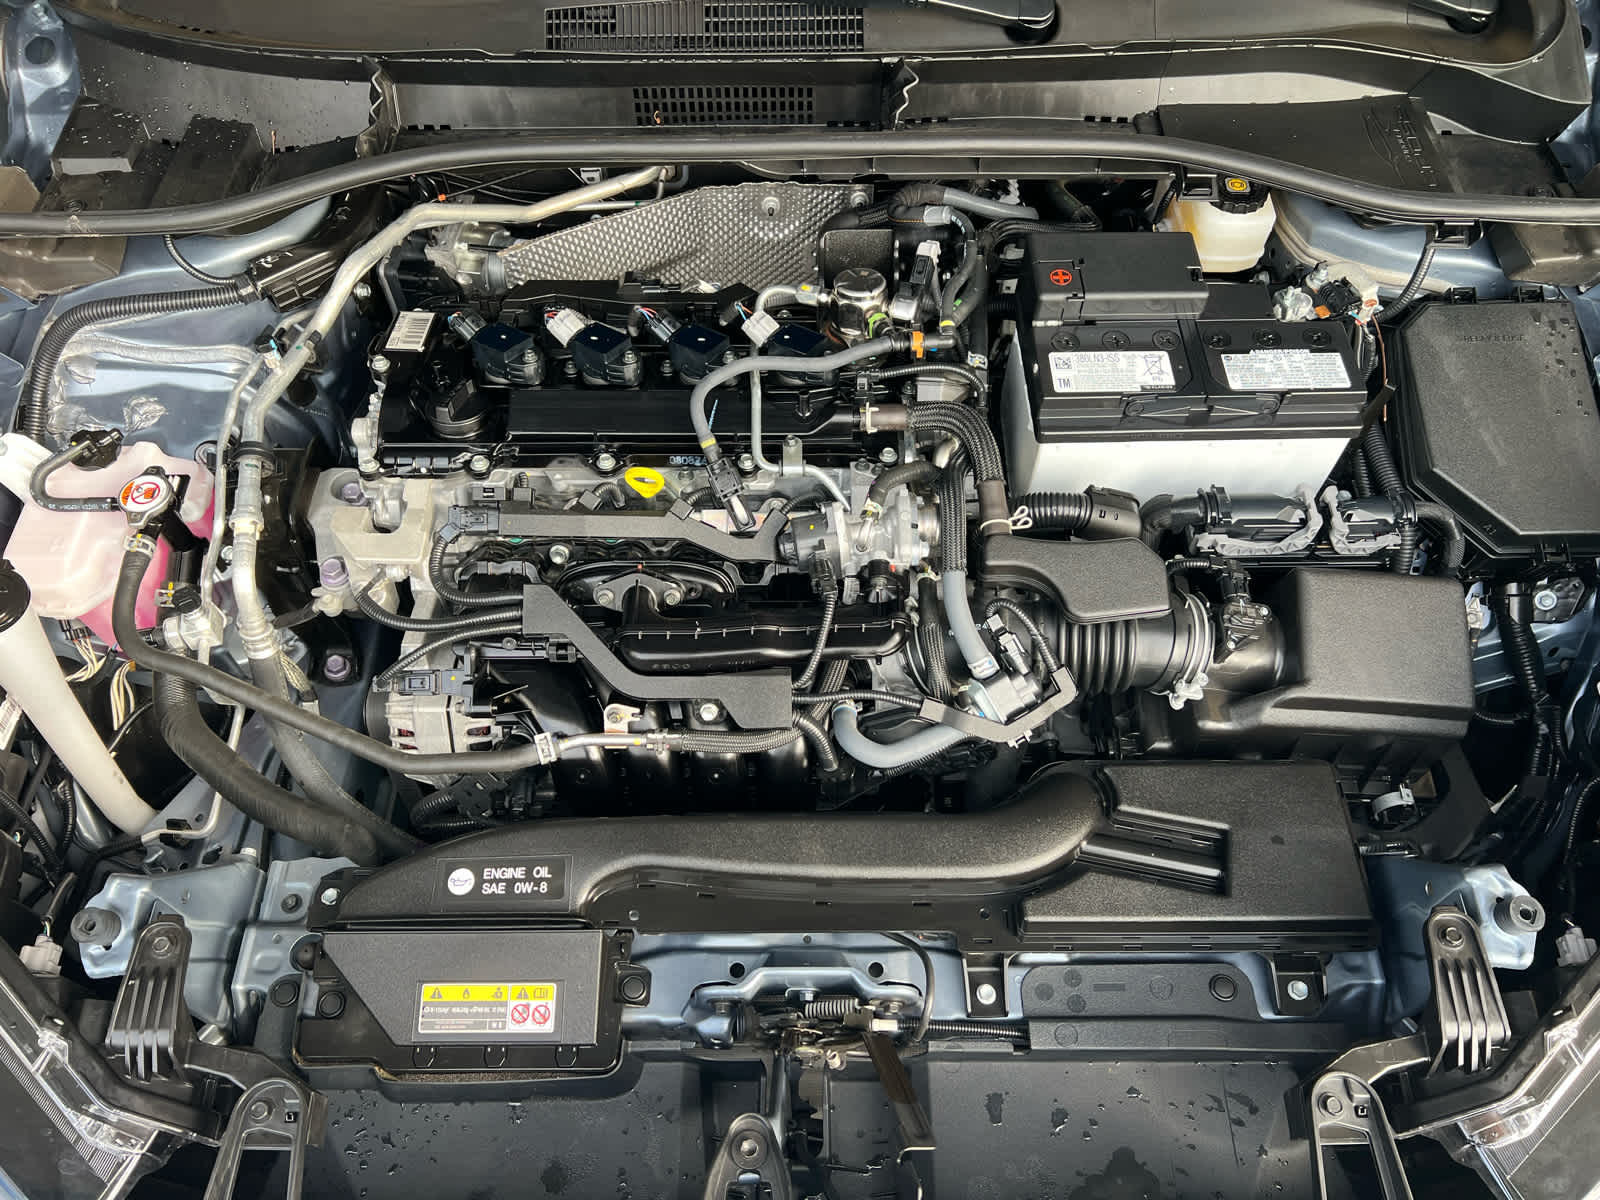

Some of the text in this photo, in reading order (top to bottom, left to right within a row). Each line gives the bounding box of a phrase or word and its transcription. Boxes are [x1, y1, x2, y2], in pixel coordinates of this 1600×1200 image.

[1057, 378, 1071, 389] TM
[483, 866, 552, 879] ENGINE OIL
[481, 881, 548, 894] SAE 0W-8
